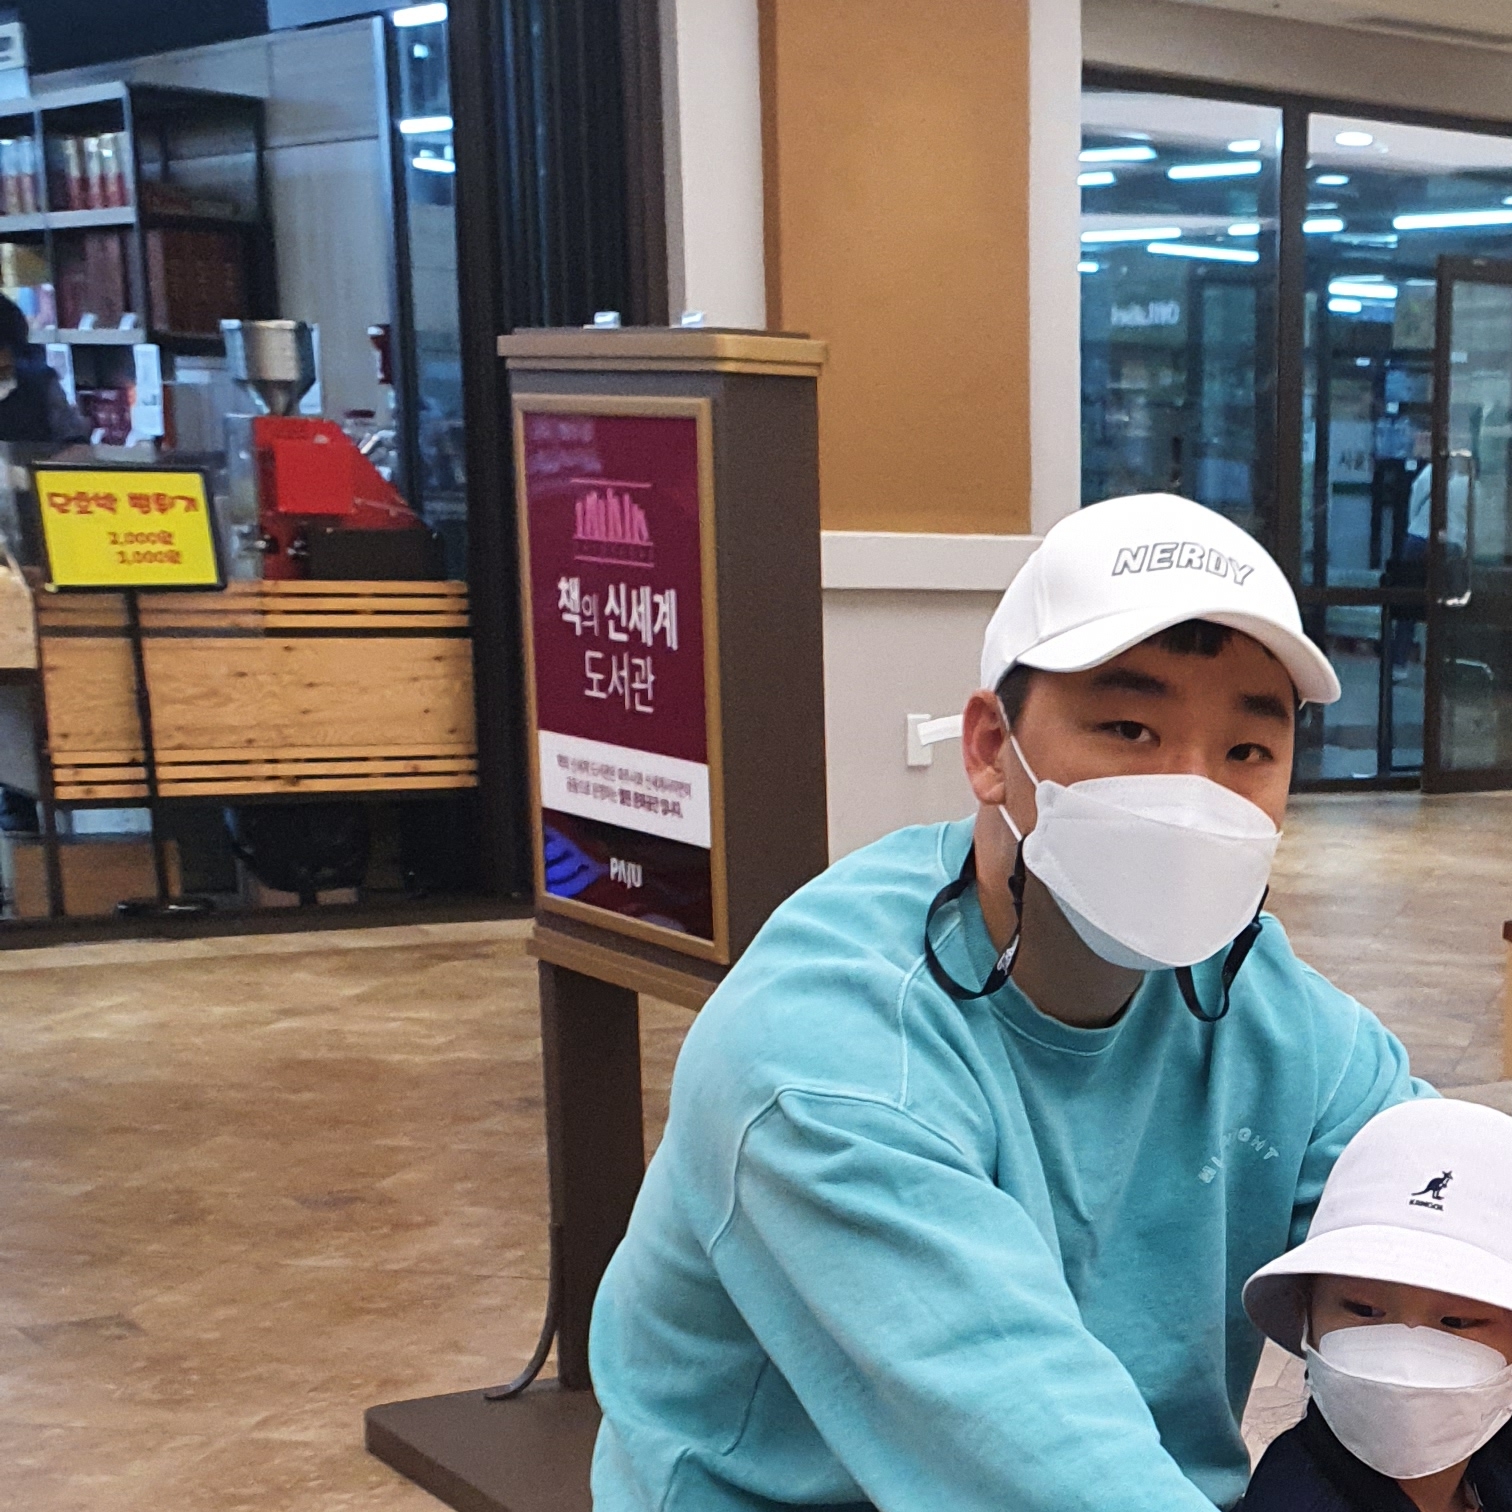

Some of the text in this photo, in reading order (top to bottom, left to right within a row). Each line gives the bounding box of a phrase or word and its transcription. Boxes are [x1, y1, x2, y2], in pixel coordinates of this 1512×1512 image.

[1110, 541, 1255, 587] NERDY
[557, 575, 679, 651] 책의 신세계
[584, 649, 655, 714] 도서관
